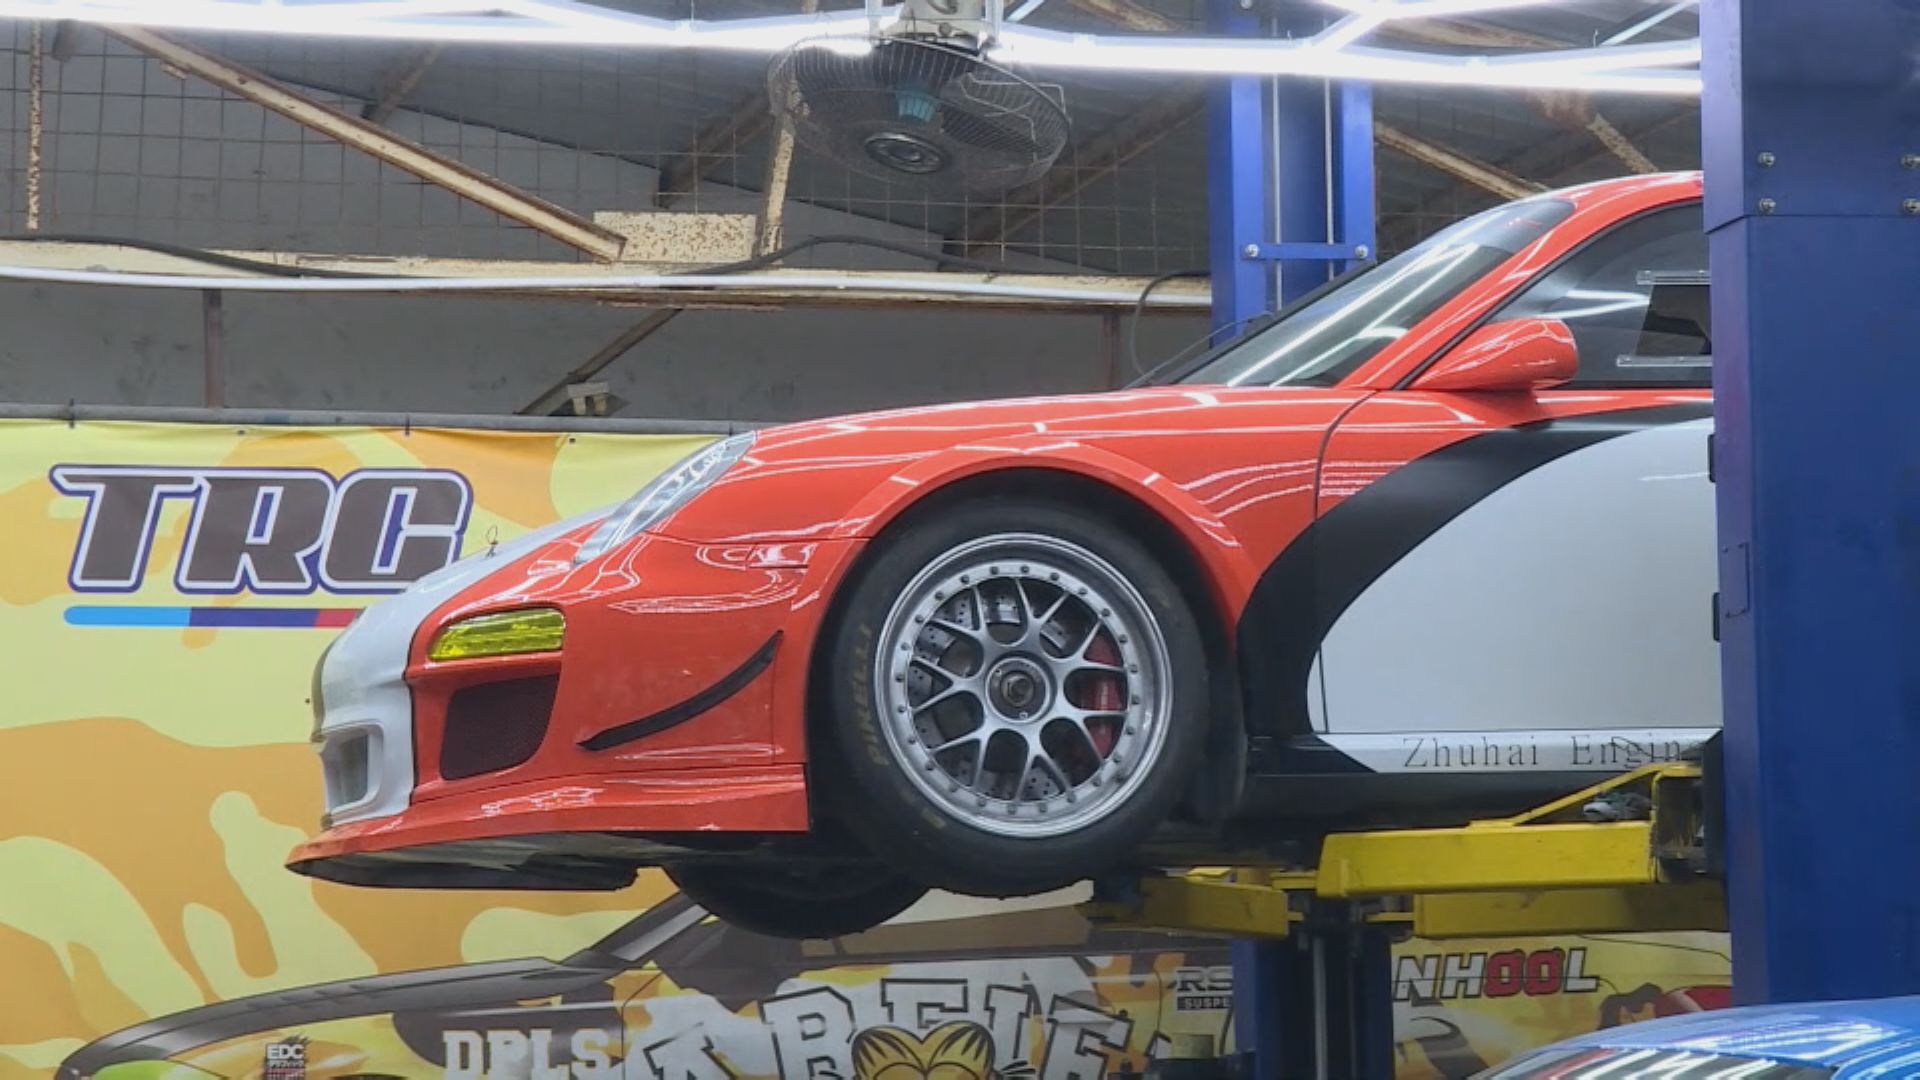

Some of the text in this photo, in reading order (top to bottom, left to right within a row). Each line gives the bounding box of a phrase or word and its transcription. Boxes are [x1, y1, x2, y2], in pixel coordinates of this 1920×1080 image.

[49, 464, 474, 594] TRC
[853, 623, 889, 766] PIRELLI
[1402, 735, 1539, 767] Zhuhai
[1391, 947, 1601, 1002] NHOOL
[266, 1043, 305, 1060] EDC
